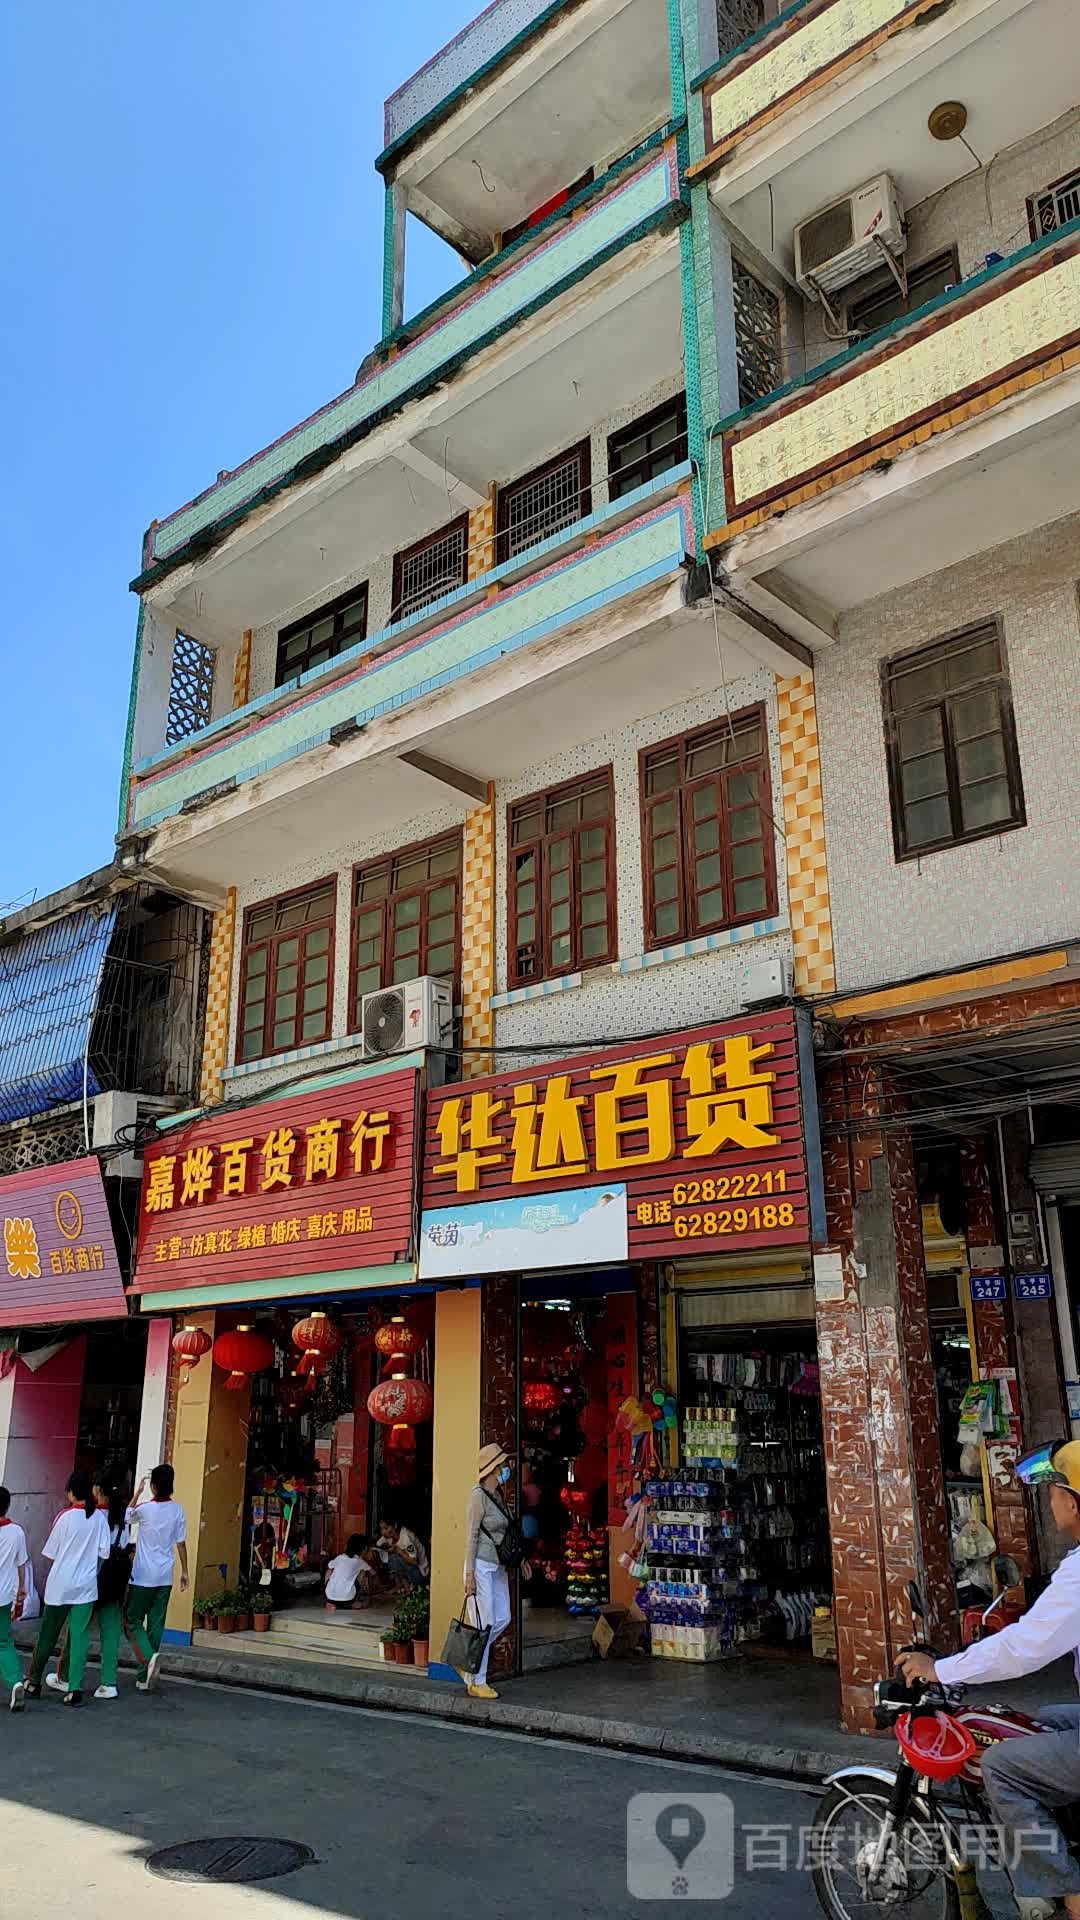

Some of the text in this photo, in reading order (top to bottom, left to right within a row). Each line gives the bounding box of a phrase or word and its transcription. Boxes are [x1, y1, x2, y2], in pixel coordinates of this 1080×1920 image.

[433, 1035, 781, 1193] 华达百货
[145, 1110, 392, 1212] 嘉烨百货商行
[673, 1168, 787, 1206] 62822211
[636, 1200, 672, 1225] 电话
[674, 1203, 794, 1238] 62829188
[49, 1245, 105, 1274] 百货商行
[977, 1286, 1000, 1298] 247
[1021, 1284, 1046, 1296] 245
